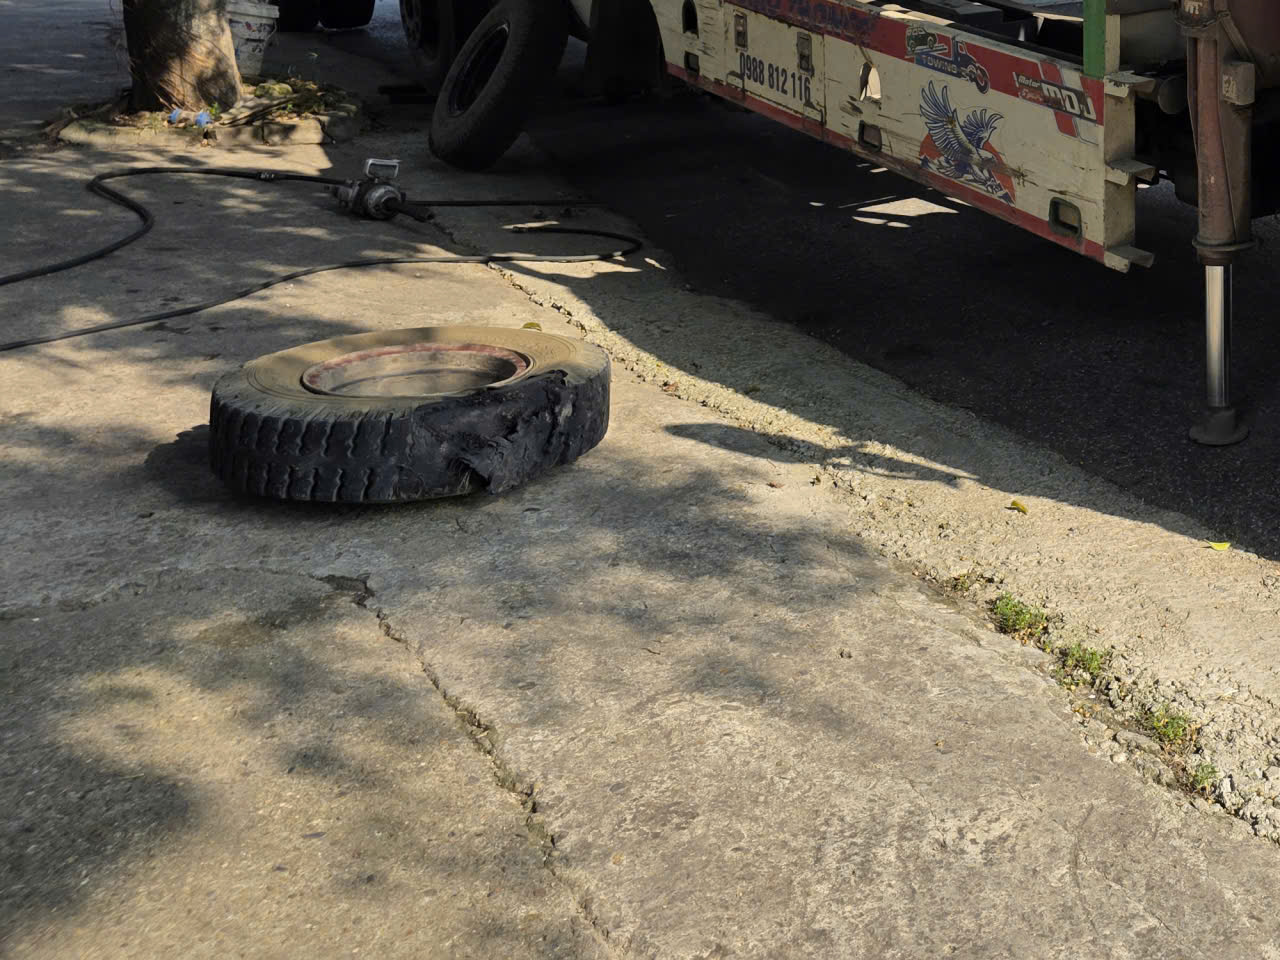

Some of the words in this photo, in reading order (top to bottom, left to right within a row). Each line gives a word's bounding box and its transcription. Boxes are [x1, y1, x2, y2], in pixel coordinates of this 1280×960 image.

[740, 52, 765, 86] 0988
[768, 63, 788, 95] 812
[791, 72, 811, 103] 116
[921, 54, 958, 74] TOWING
